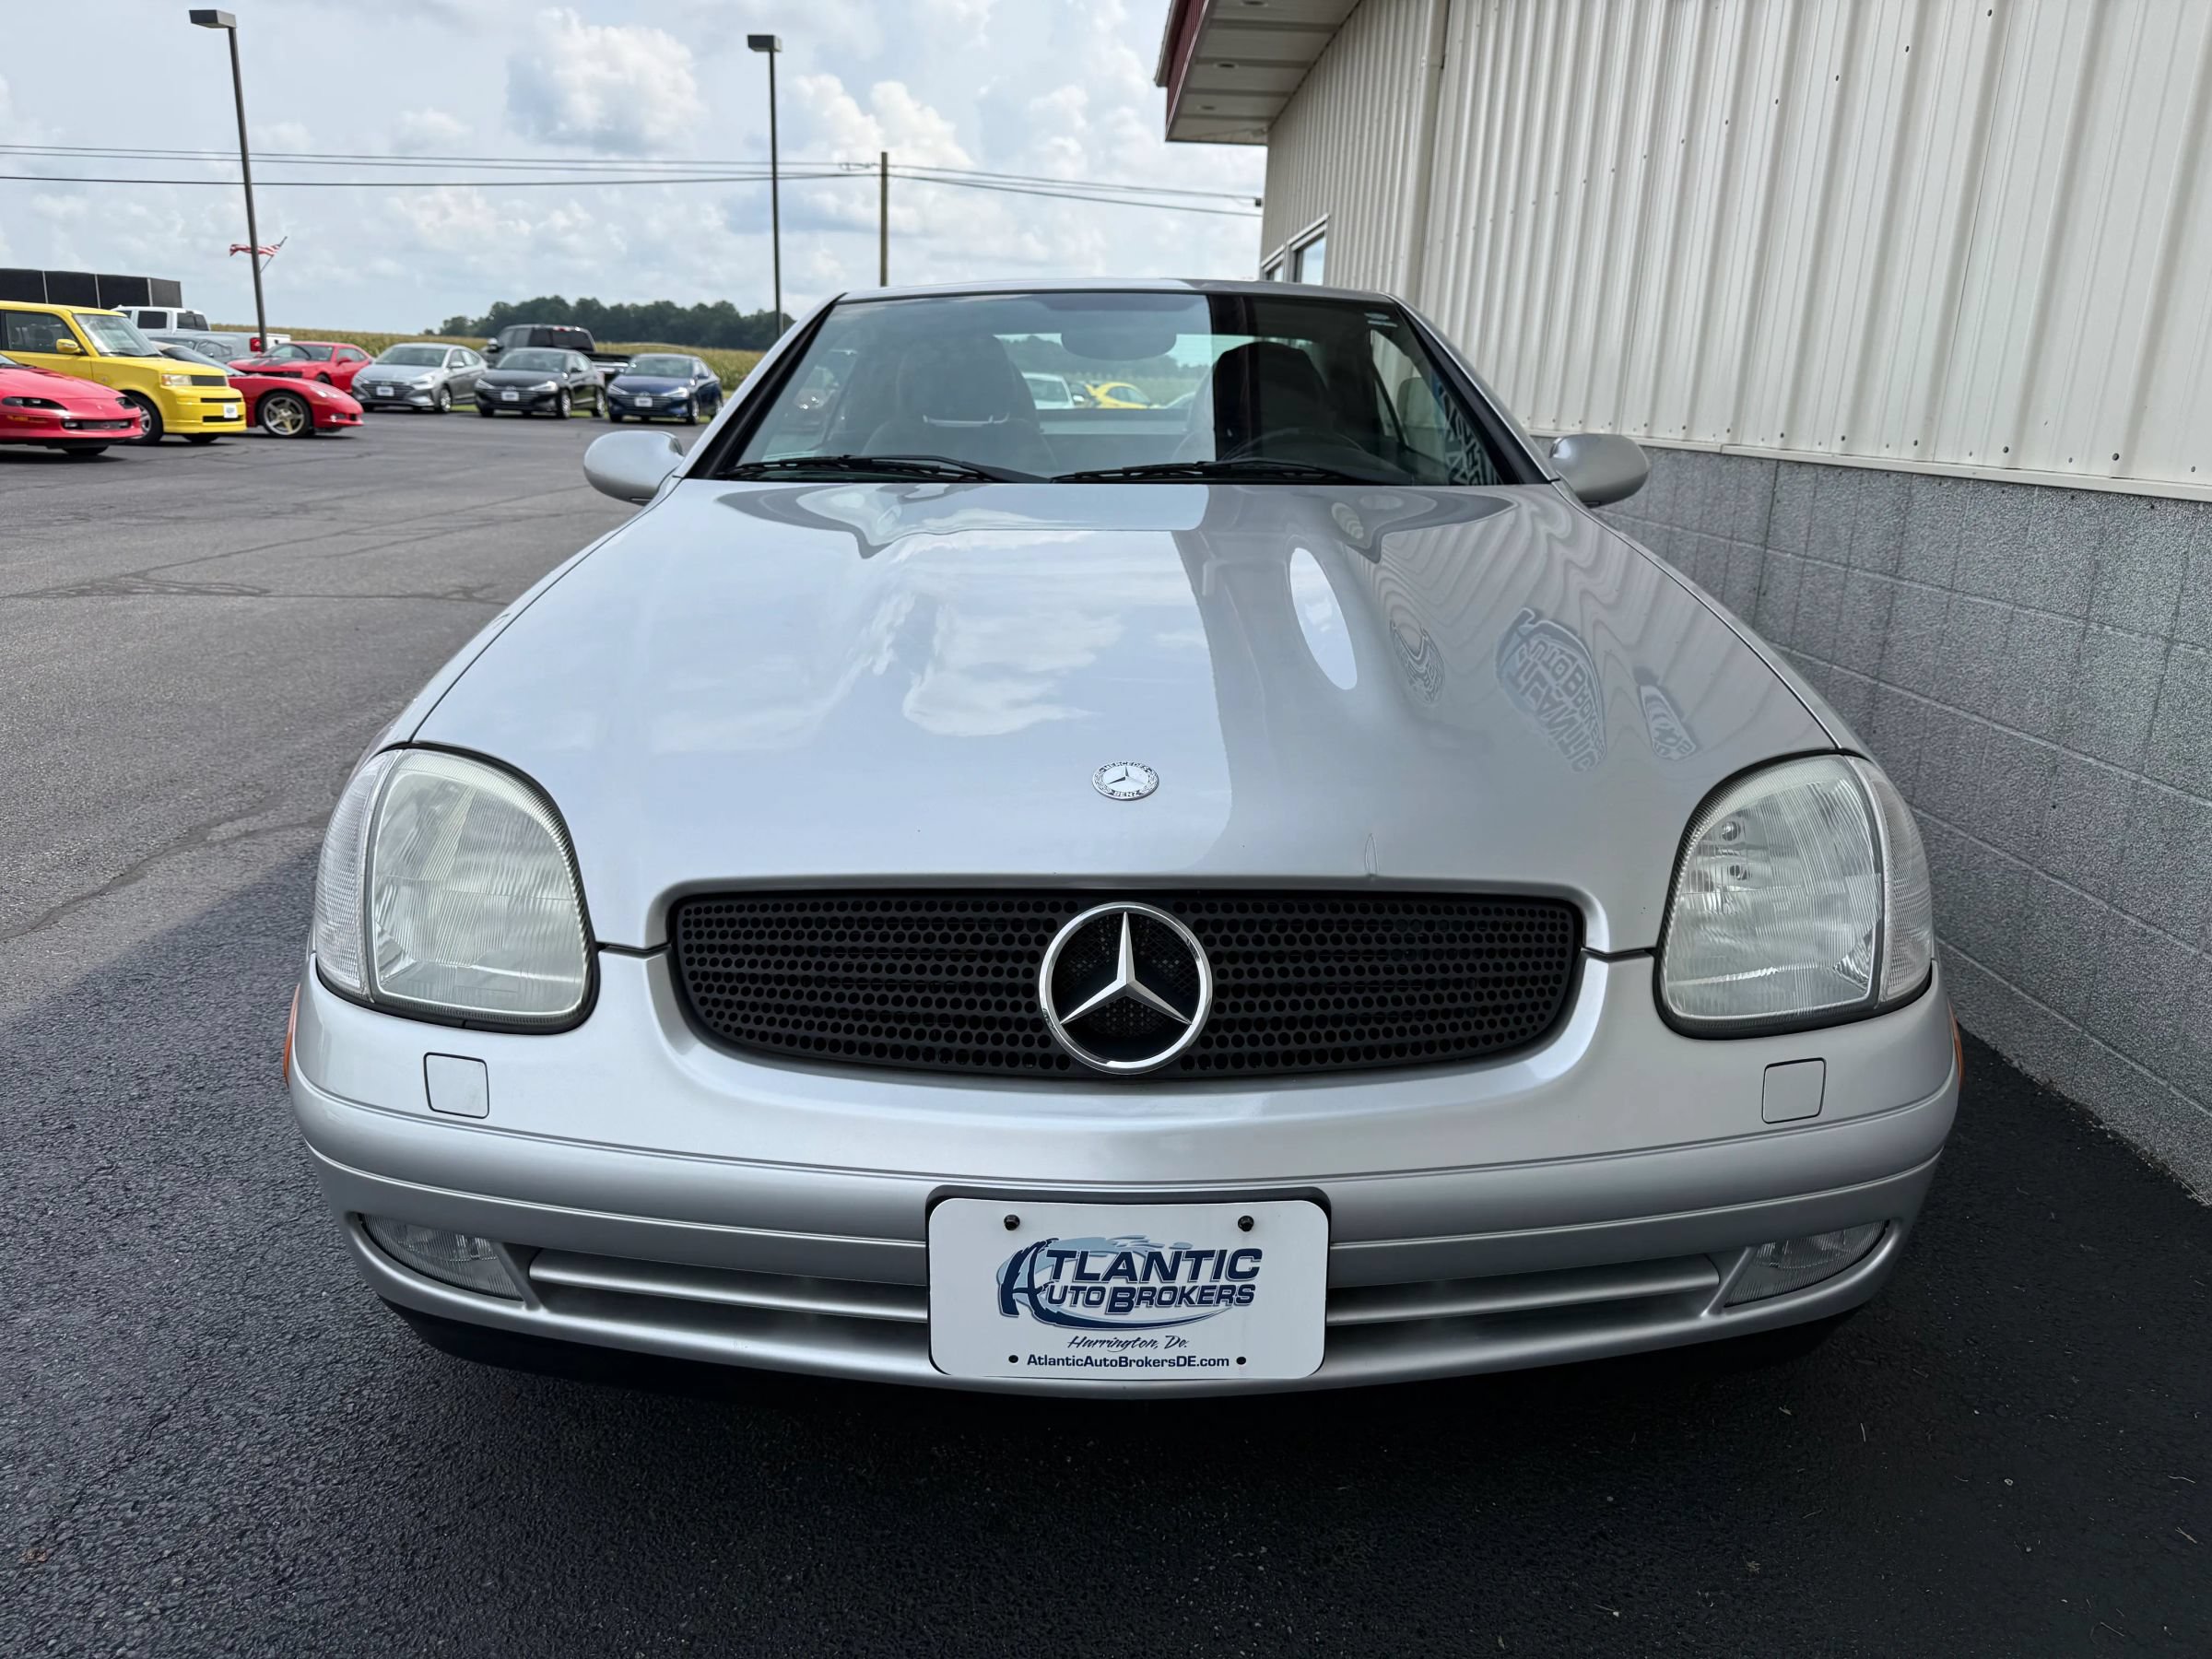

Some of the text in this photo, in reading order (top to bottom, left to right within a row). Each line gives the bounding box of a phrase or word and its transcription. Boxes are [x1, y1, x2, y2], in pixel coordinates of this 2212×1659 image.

[1000, 1238, 1263, 1315] ATLANTIC
[1067, 1335, 1189, 1353] Harrington, De.
[1027, 1353, 1230, 1368] AtlanticAutoBrokersDE.com
